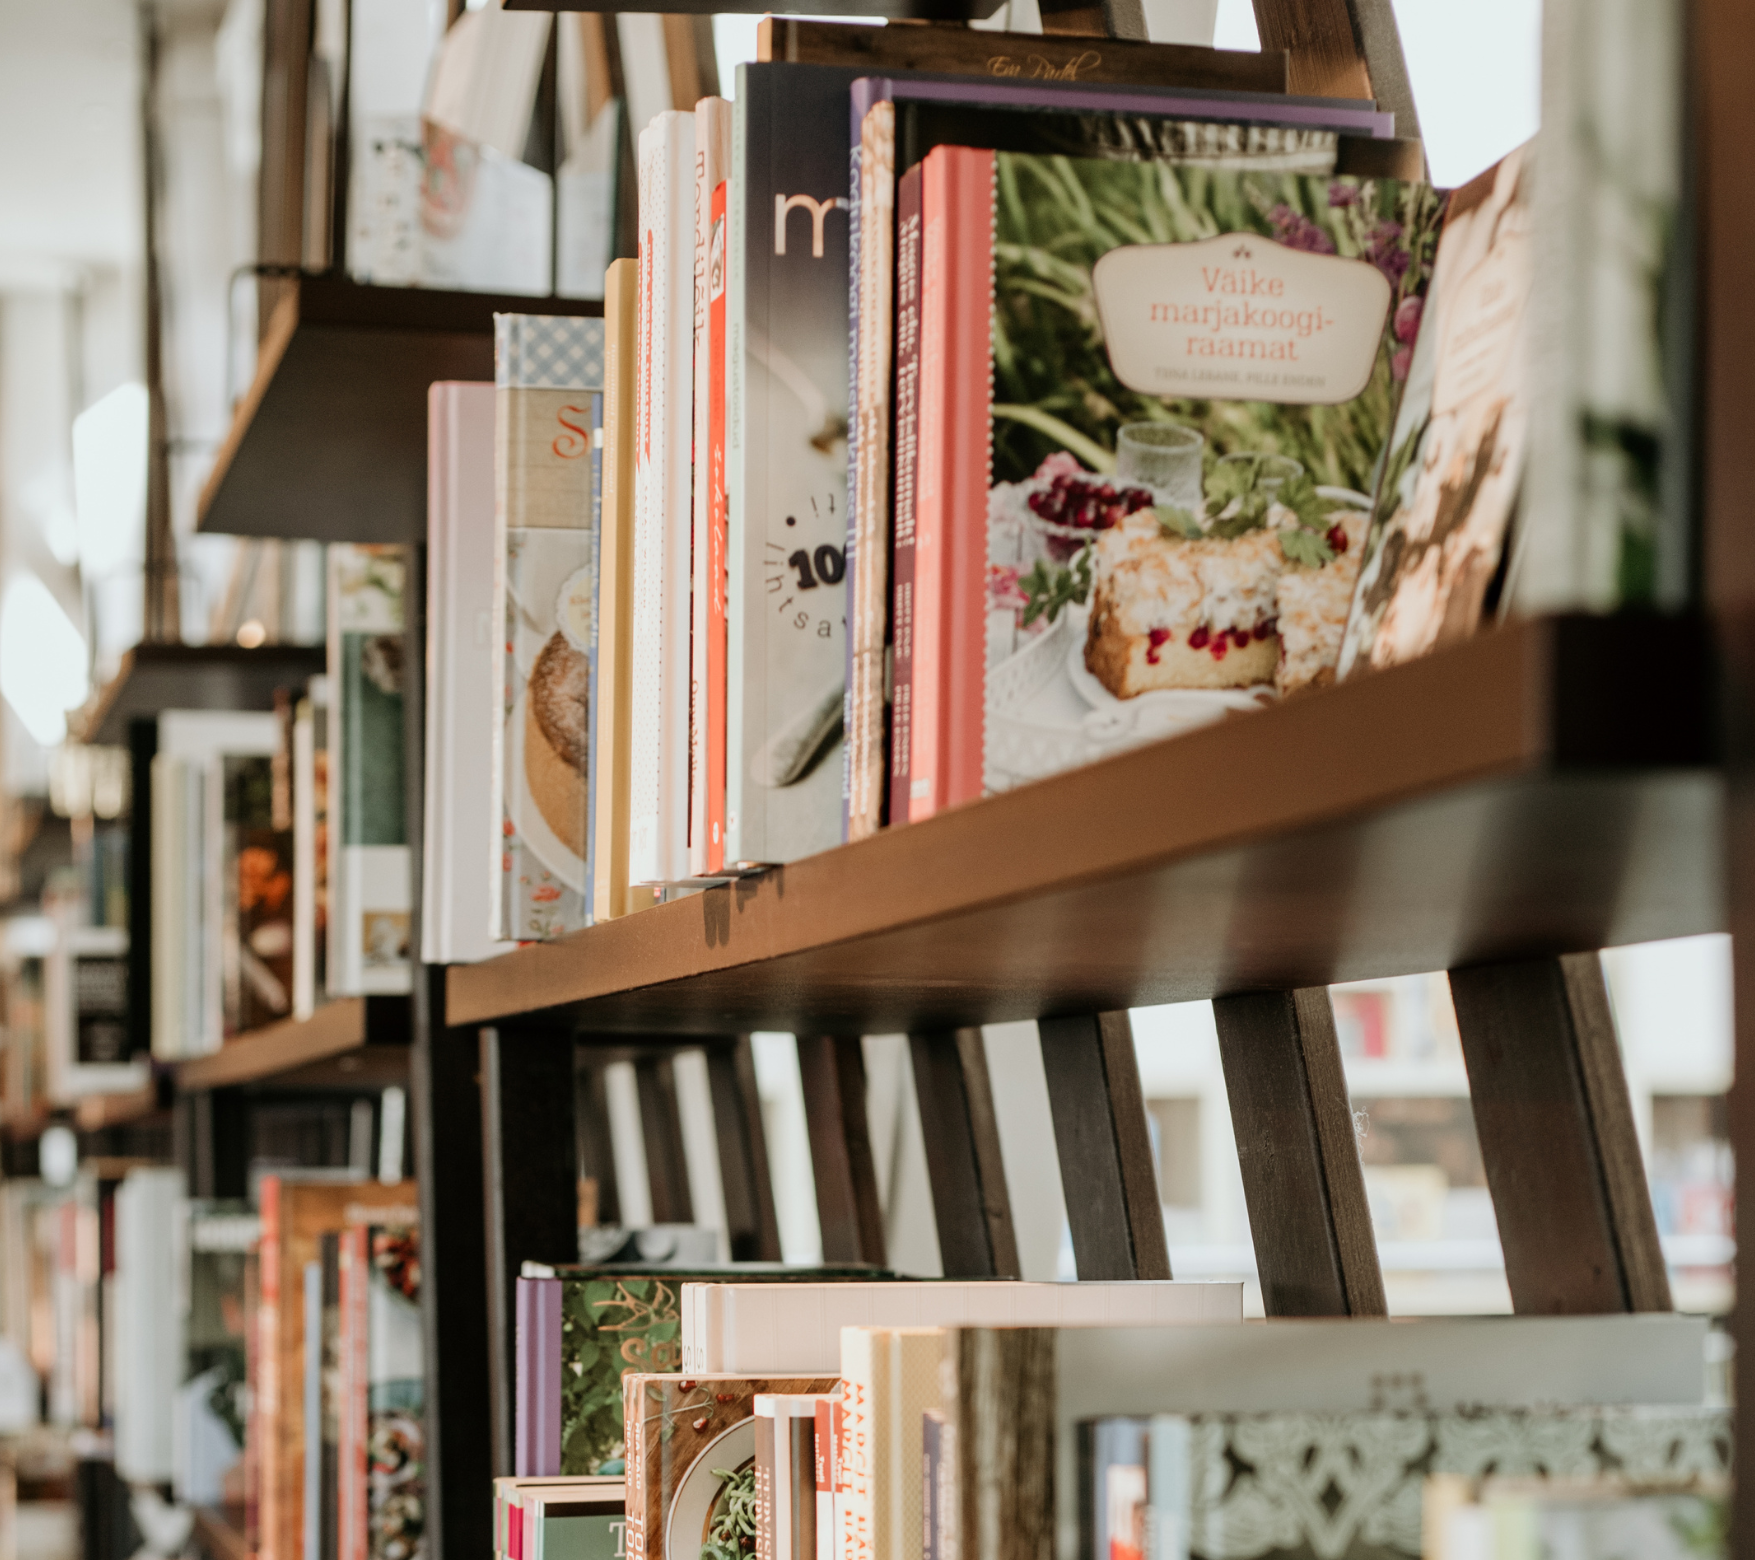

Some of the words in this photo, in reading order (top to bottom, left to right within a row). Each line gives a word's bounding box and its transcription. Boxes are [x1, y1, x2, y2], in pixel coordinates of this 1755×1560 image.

[1203, 267, 1285, 298] Väike
[1151, 300, 1335, 337] marjakoogi-
[1187, 336, 1300, 361] raamat
[855, 1384, 869, 1499] MARGIT
